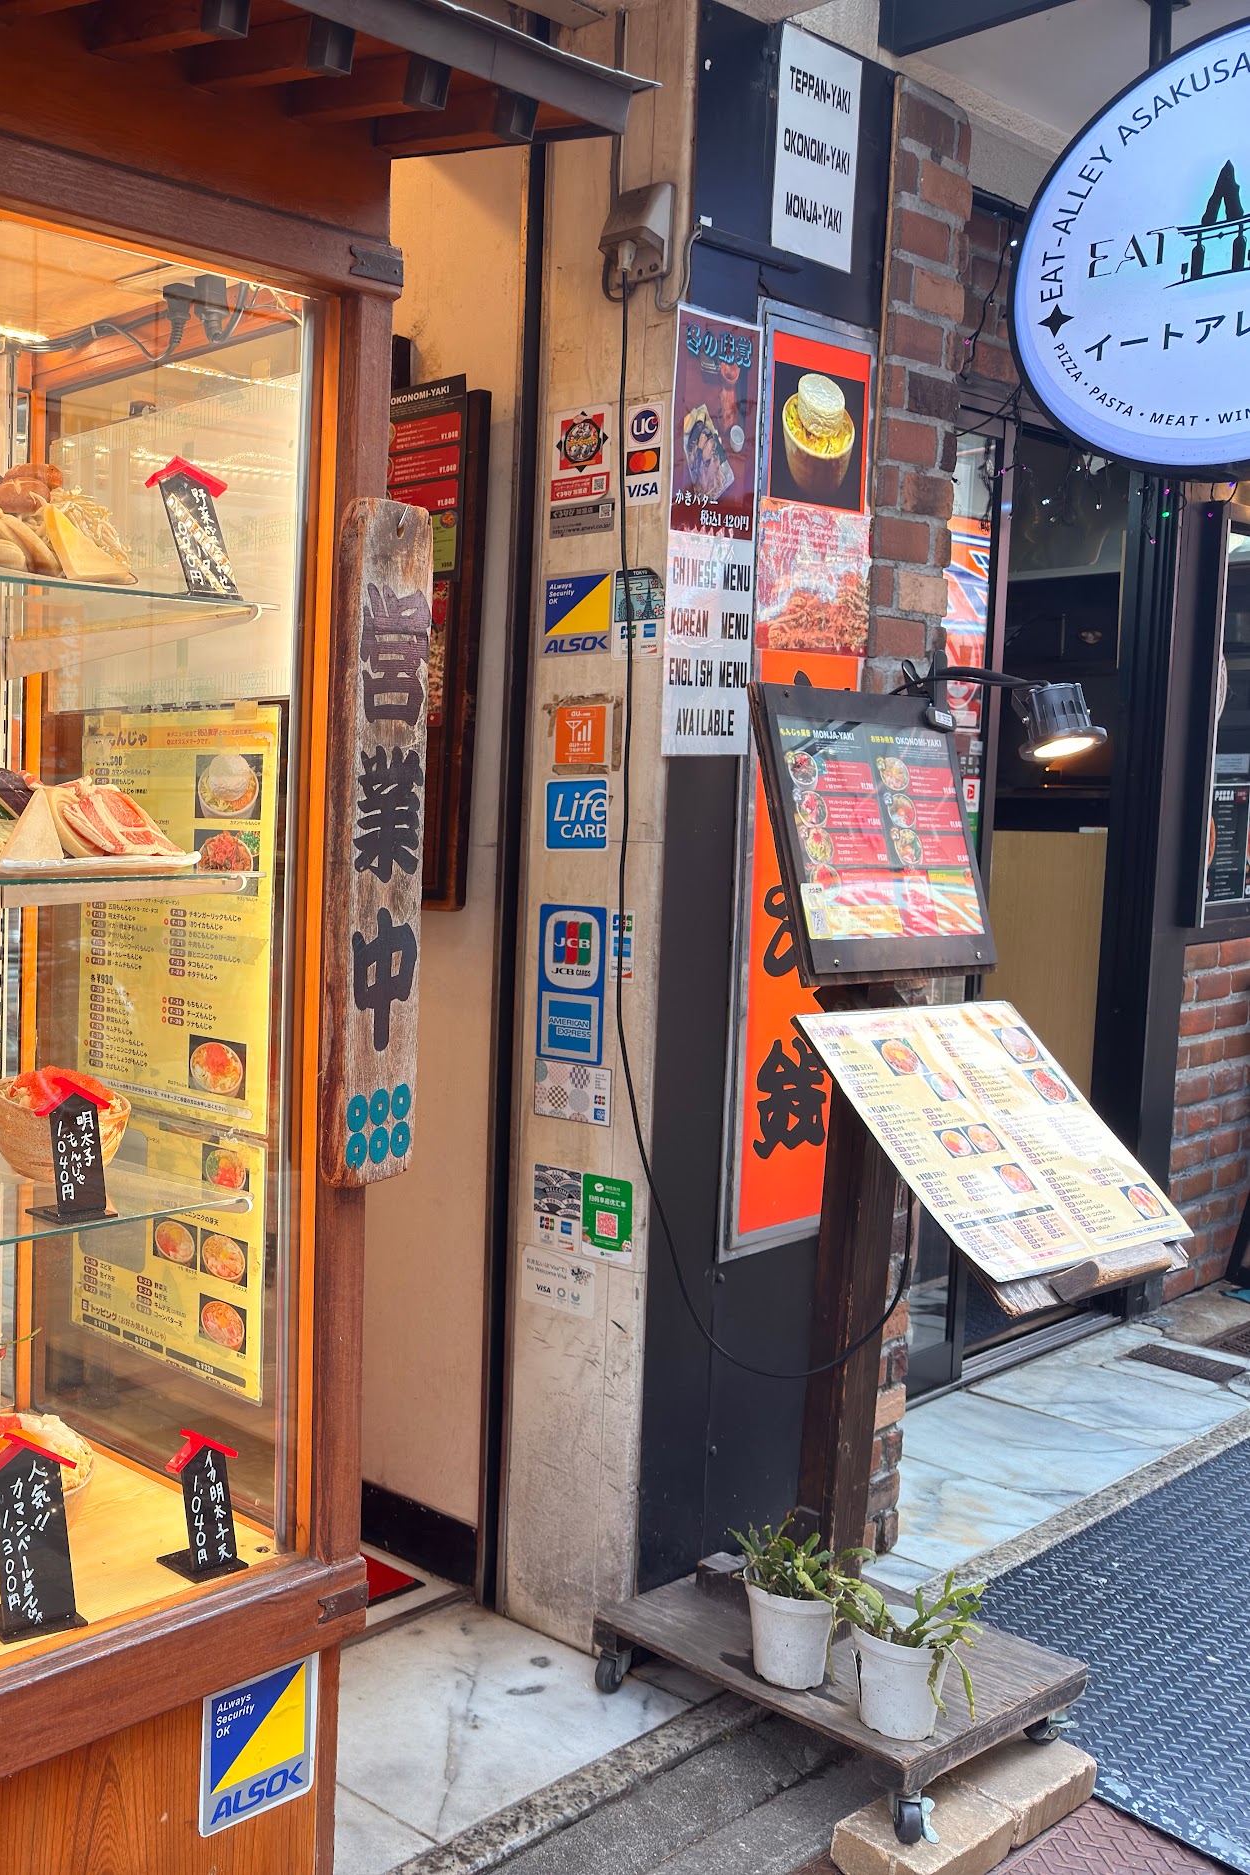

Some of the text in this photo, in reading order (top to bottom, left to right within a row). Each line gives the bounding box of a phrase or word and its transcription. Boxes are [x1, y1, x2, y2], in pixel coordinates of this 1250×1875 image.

[790, 65, 851, 114] TEPPAN-YAKI
[784, 128, 850, 175] OKONOMI-YAKI
[785, 191, 842, 233] MONJA-YAKI
[686, 322, 753, 368] 冬の味覚
[1054, 343, 1198, 426] PIZZA PASTA MEAT
[390, 385, 450, 405] OKONOMI-YAKI
[627, 482, 658, 497] VISA
[675, 489, 719, 508] かきバター
[672, 556, 751, 592] CHINESE MENU
[548, 589, 575, 597] Security
[670, 607, 749, 640] KOREAN MENU
[544, 635, 608, 653] ALSOK
[669, 657, 748, 689] ENGLISH MENU
[675, 708, 735, 737] AVAILABLE
[812, 730, 855, 741] MONJA-YAKI
[895, 736, 942, 748] OKONOMI-YAKI
[553, 788, 607, 822] Life
[352, 583, 430, 1052] 営業中
[560, 824, 607, 838] CARD
[188, 911, 242, 922] チキンガーリックもんじゃ
[554, 937, 591, 949] JCB
[187, 961, 214, 970] タコもんじゃ
[551, 967, 591, 977] JCB CARDS
[187, 971, 218, 980] ホタテもんじゃ
[187, 1000, 212, 1010] もちもんじゃ
[187, 1010, 217, 1021] チーズもんじゃ
[549, 1017, 589, 1028] AMERICAN
[186, 1020, 212, 1030] ツナもんじゃ
[557, 1028, 591, 1038] EXPRESS
[76, 1111, 95, 1167] 明太子
[67, 1132, 86, 1185] もんじゃ
[537, 1284, 551, 1294] VISA
[91, 1304, 117, 1321] トッピング
[216, 1692, 252, 1715] ALways
[216, 1703, 255, 1727] Security
[215, 1724, 230, 1739] OK
[210, 1761, 304, 1826] ALSOK
